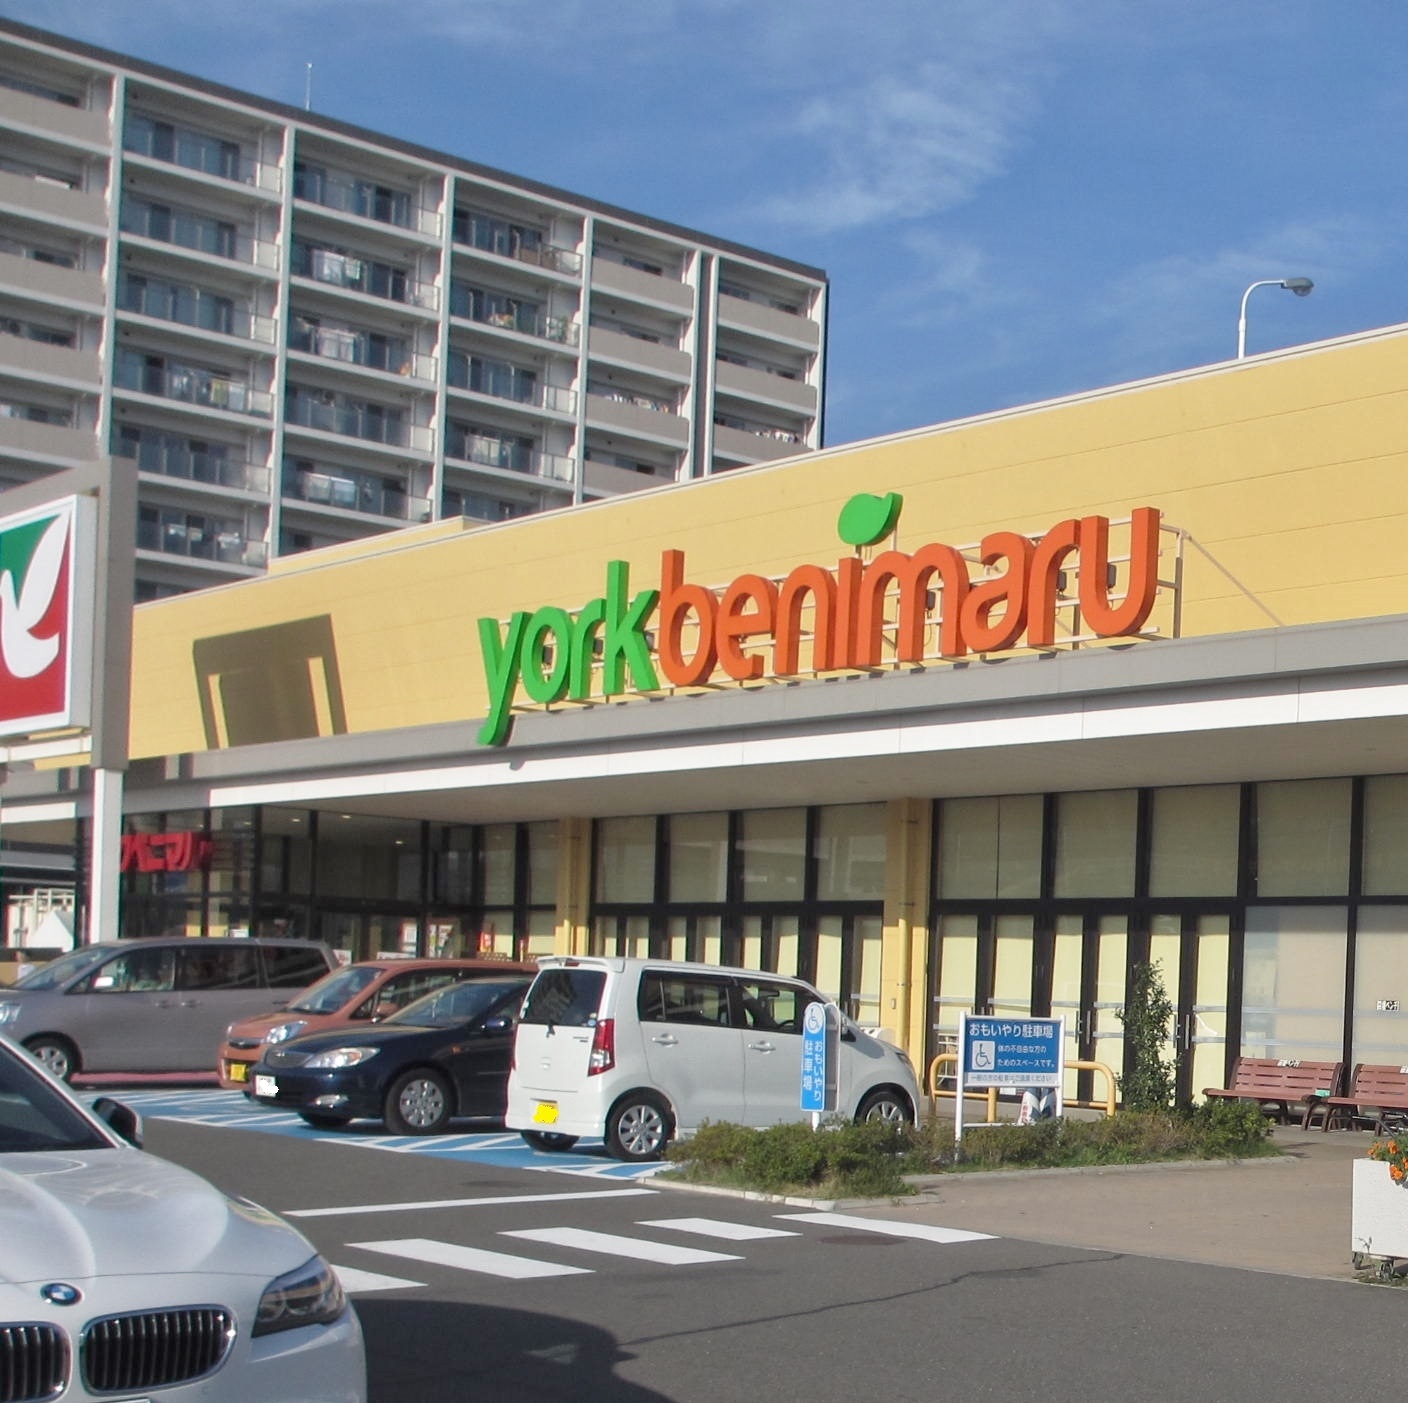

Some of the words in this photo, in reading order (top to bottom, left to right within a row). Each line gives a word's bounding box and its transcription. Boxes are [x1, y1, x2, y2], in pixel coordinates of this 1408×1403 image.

[969, 1023, 1053, 1039] おもいやり駐車場
[803, 1039, 813, 1090] 駐車場
[813, 1040, 823, 1101] おもいやり
